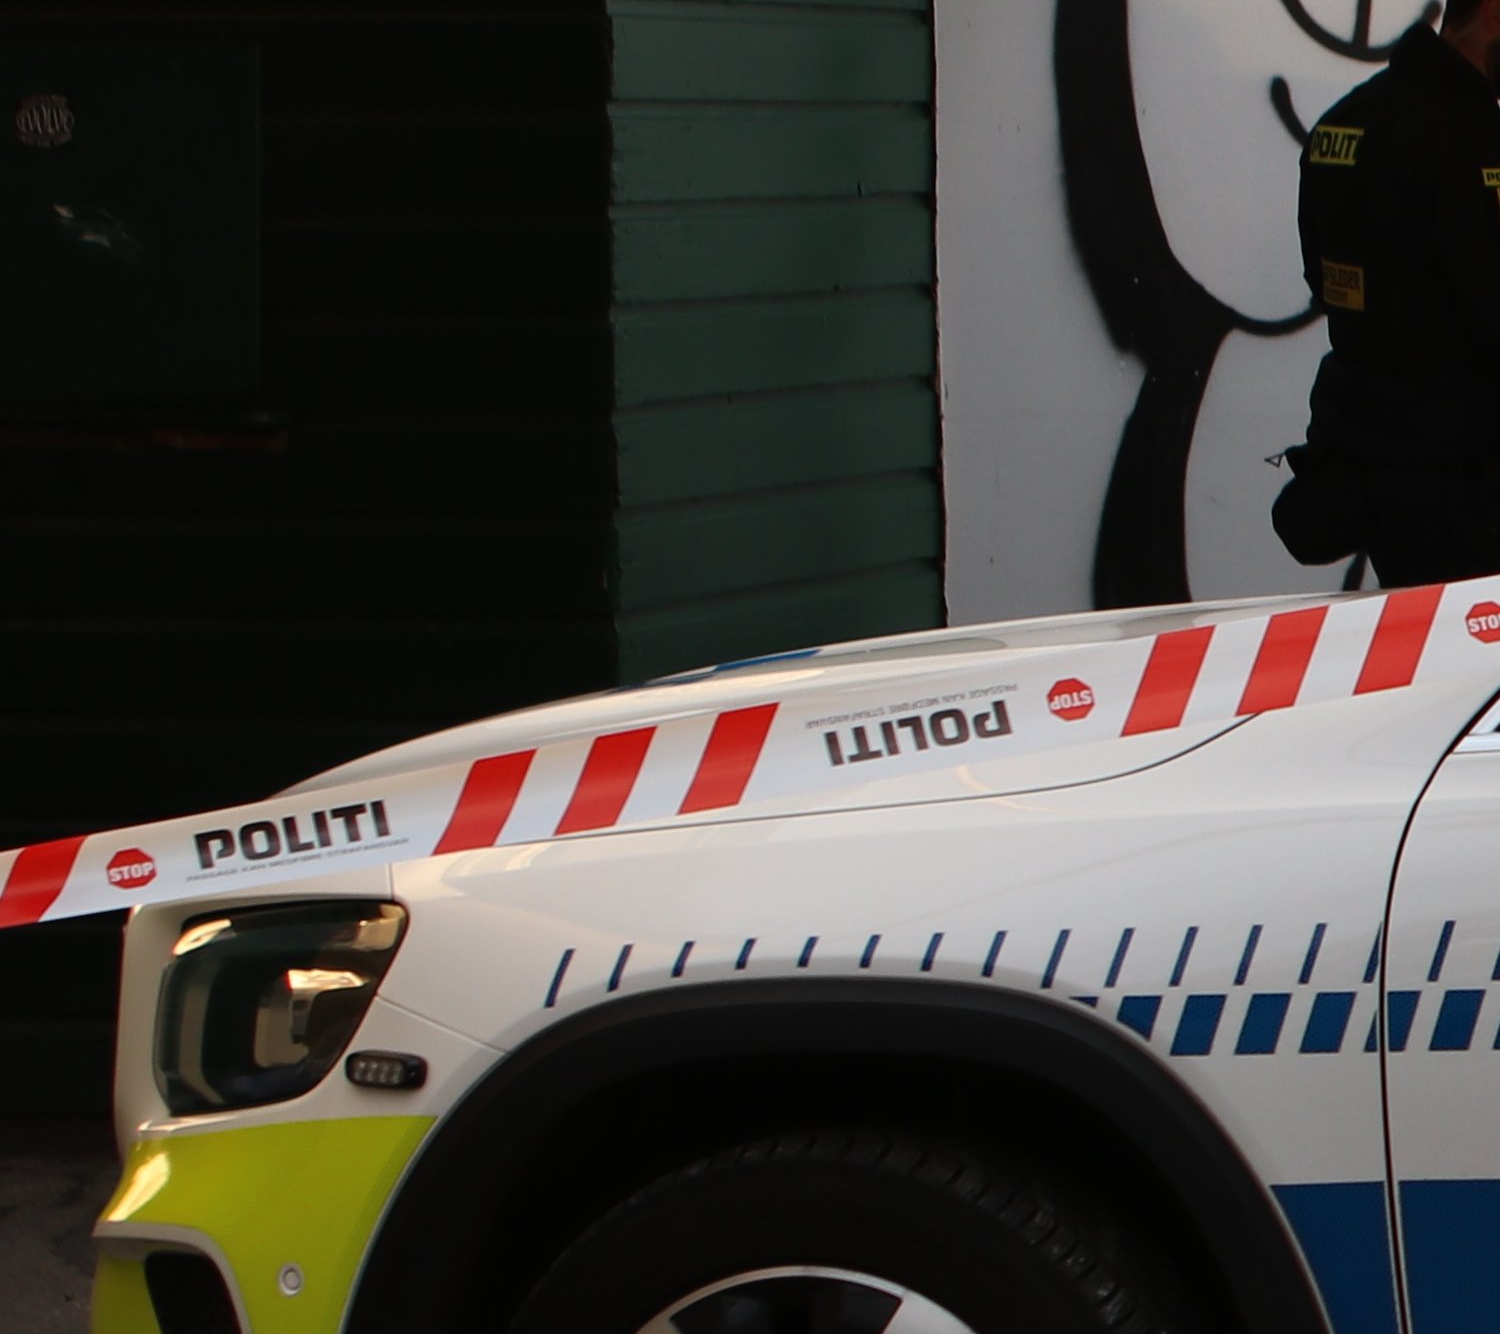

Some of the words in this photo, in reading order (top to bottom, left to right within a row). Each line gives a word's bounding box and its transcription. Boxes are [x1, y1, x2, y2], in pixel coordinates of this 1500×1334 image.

[1048, 688, 1093, 710] STOP
[823, 699, 1013, 766] POLITI
[193, 800, 390, 869] POLITI
[107, 860, 154, 881] STOP
